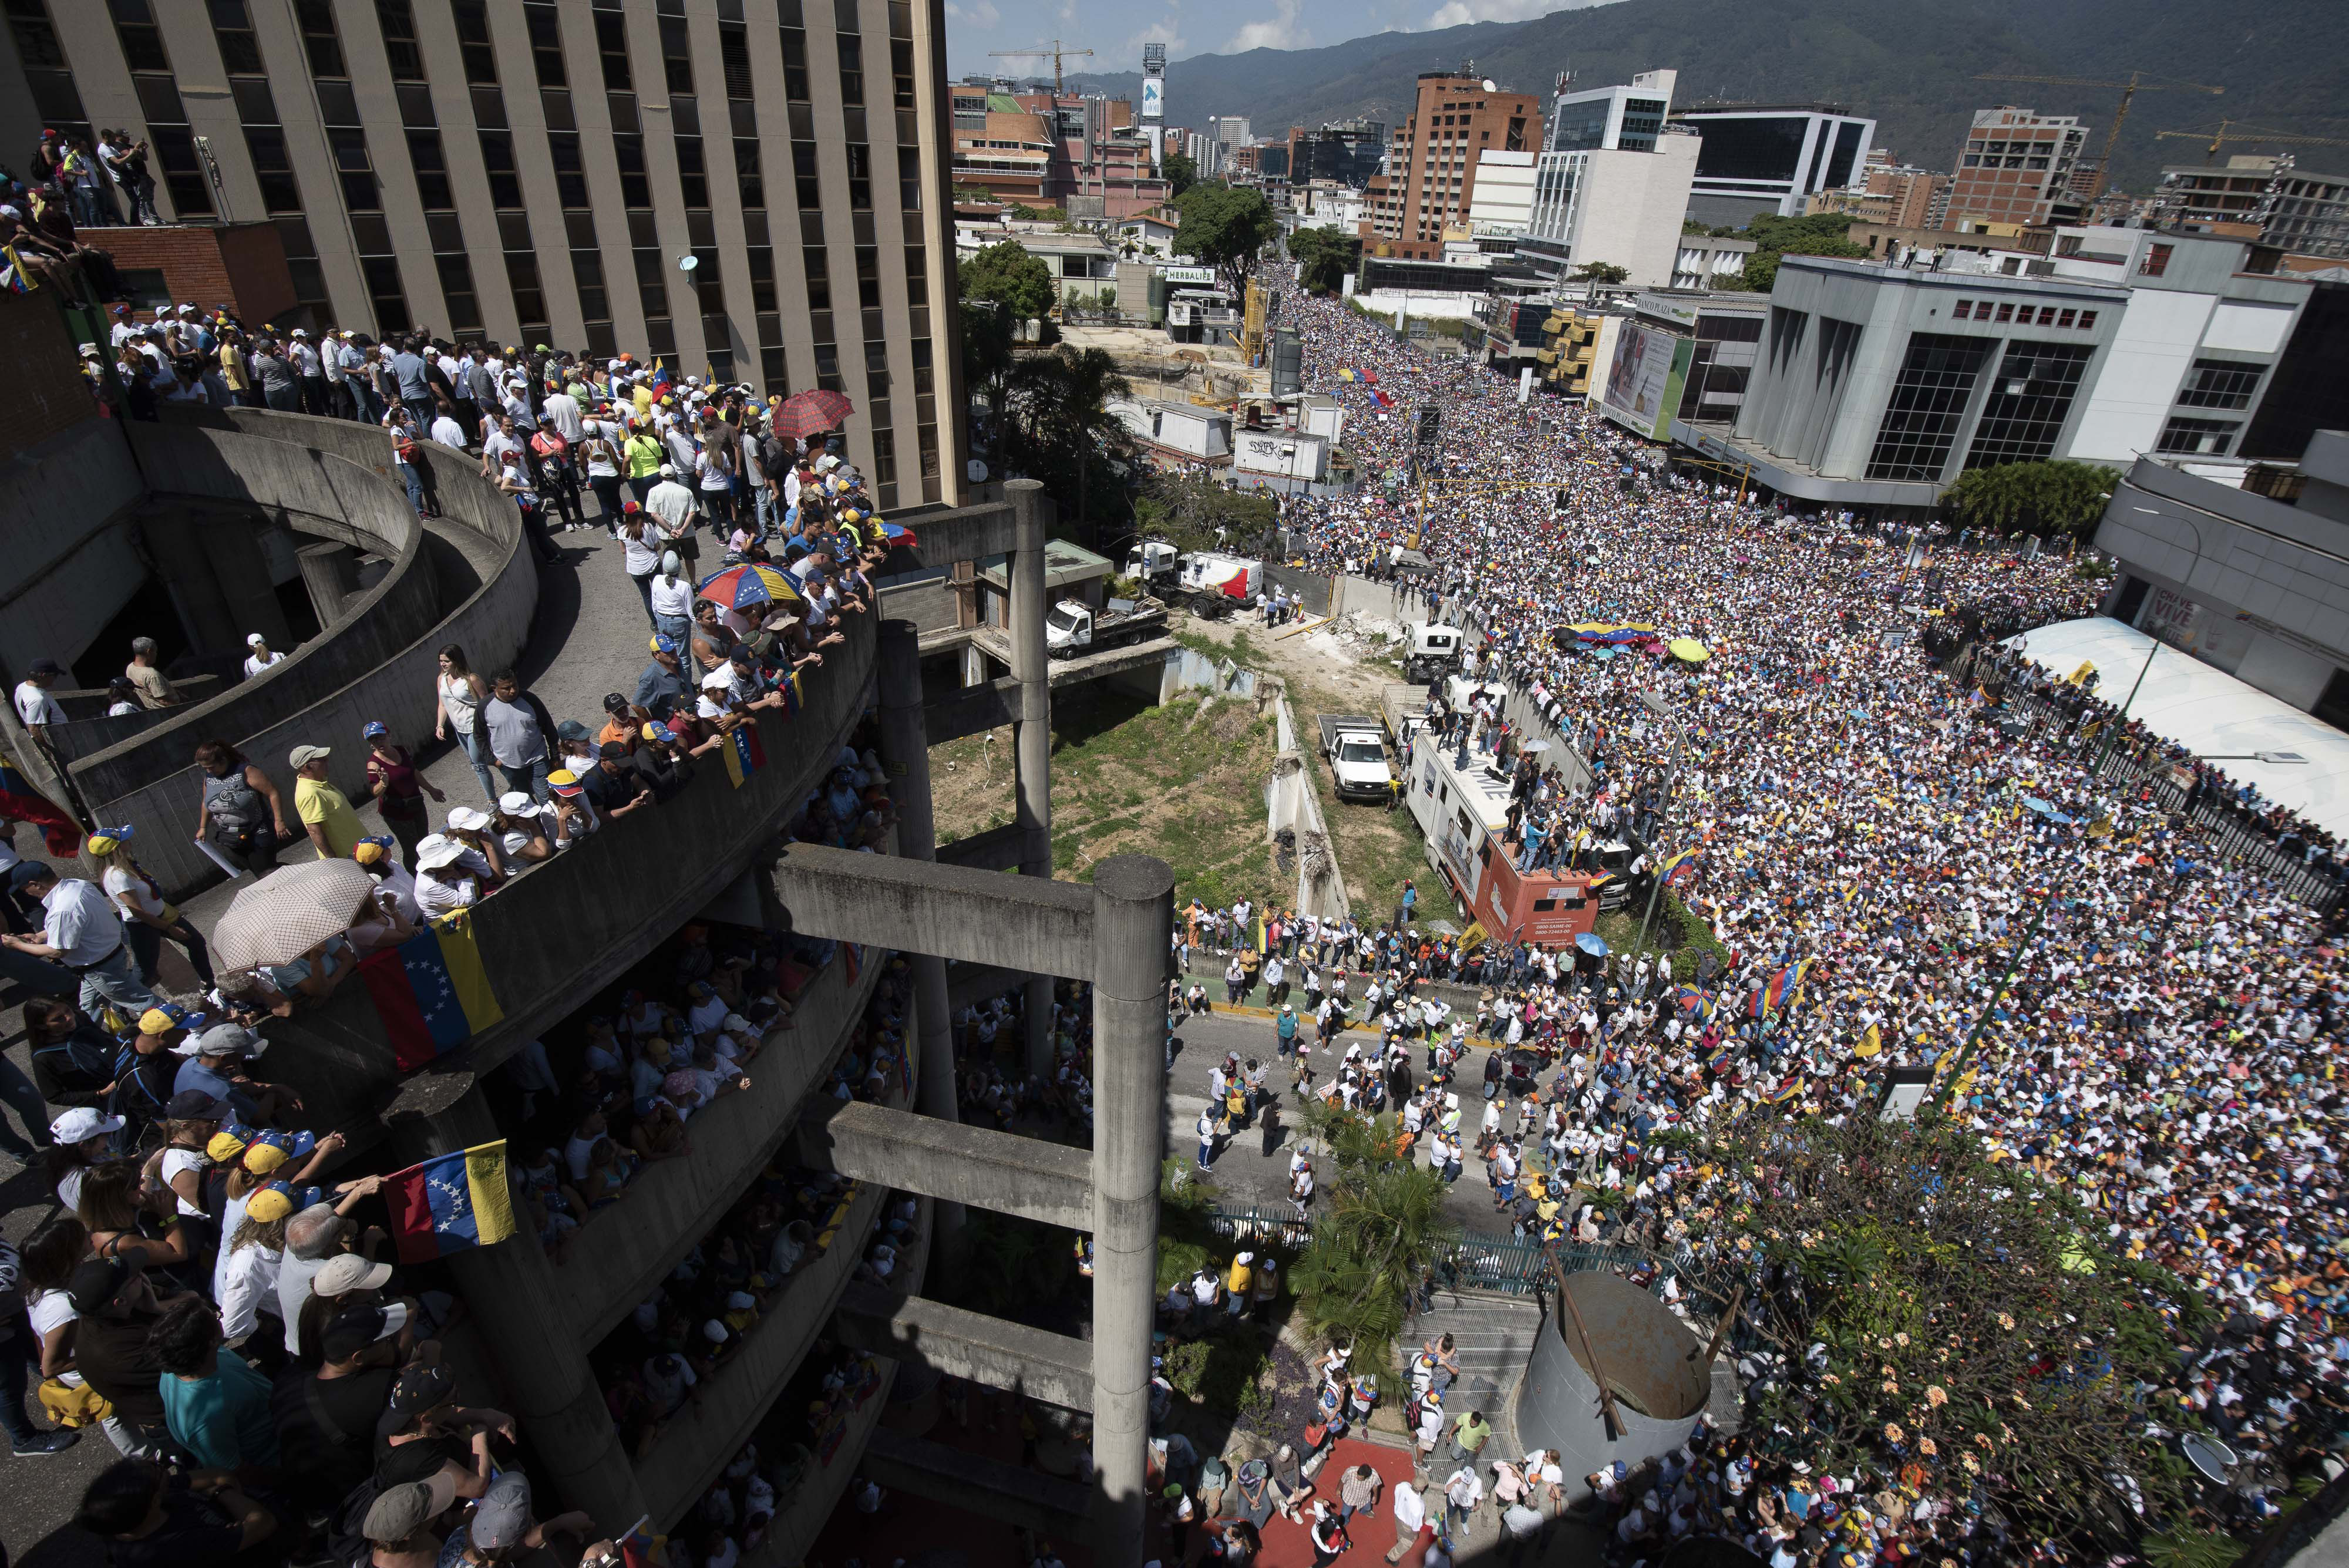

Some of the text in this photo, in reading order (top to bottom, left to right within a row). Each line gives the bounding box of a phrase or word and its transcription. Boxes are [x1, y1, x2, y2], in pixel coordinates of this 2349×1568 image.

[1637, 298, 1670, 315] BANCO PLAZA
[1601, 404, 1630, 426] BANCO PLAZA
[759, 564, 797, 587] VENEZUELA
[2155, 600, 2193, 627] VIVE
